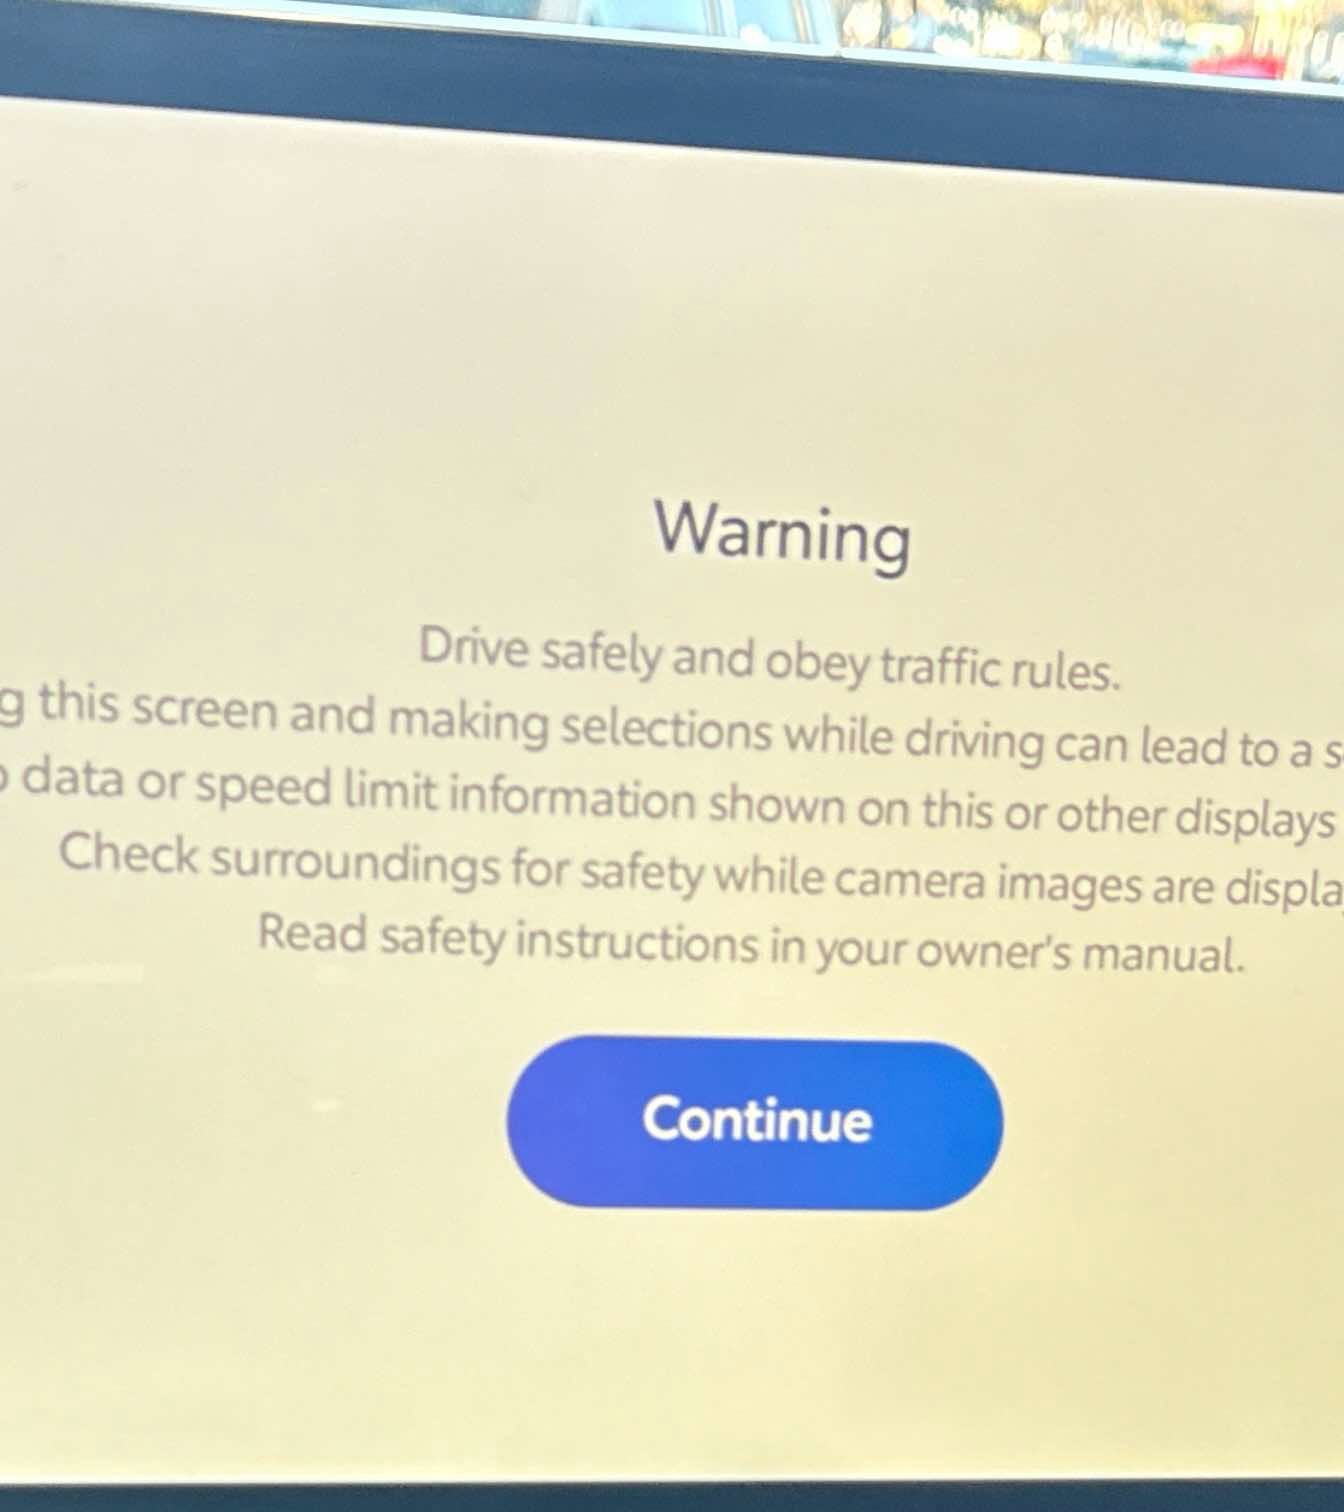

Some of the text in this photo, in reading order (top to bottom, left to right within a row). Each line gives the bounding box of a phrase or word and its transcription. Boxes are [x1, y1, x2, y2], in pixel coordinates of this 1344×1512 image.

[653, 498, 911, 581] Warning
[421, 624, 1120, 692] Drive safely and obey traffic rules.
[38, 679, 120, 723] this
[133, 694, 277, 730] screen
[290, 694, 375, 735] and
[390, 698, 550, 753] making
[562, 705, 772, 751] selections
[783, 712, 895, 756] while
[905, 717, 1045, 770] driving
[1056, 733, 1128, 762] can
[1142, 724, 1228, 765] lead
[1239, 732, 1279, 767] to
[1290, 740, 1312, 768] a
[22, 753, 124, 798] data
[137, 769, 186, 800] or
[196, 766, 331, 812] speed
[345, 766, 439, 811] limit
[450, 772, 696, 820] information
[709, 782, 846, 824] shown
[858, 797, 910, 827] on
[922, 789, 994, 830] this
[1005, 802, 1049, 831] or
[1057, 794, 1168, 834] other
[1176, 797, 1336, 848] displays
[59, 830, 199, 874] Check
[211, 842, 501, 894] surroundings
[512, 846, 571, 888] for
[581, 850, 706, 902] safety
[713, 853, 826, 895] while
[835, 867, 986, 900] camera
[998, 862, 1144, 912] images
[1153, 876, 1215, 904] are
[259, 912, 1245, 975] Read safety instructions in your owner's manual.
[643, 1094, 873, 1143] Continue
